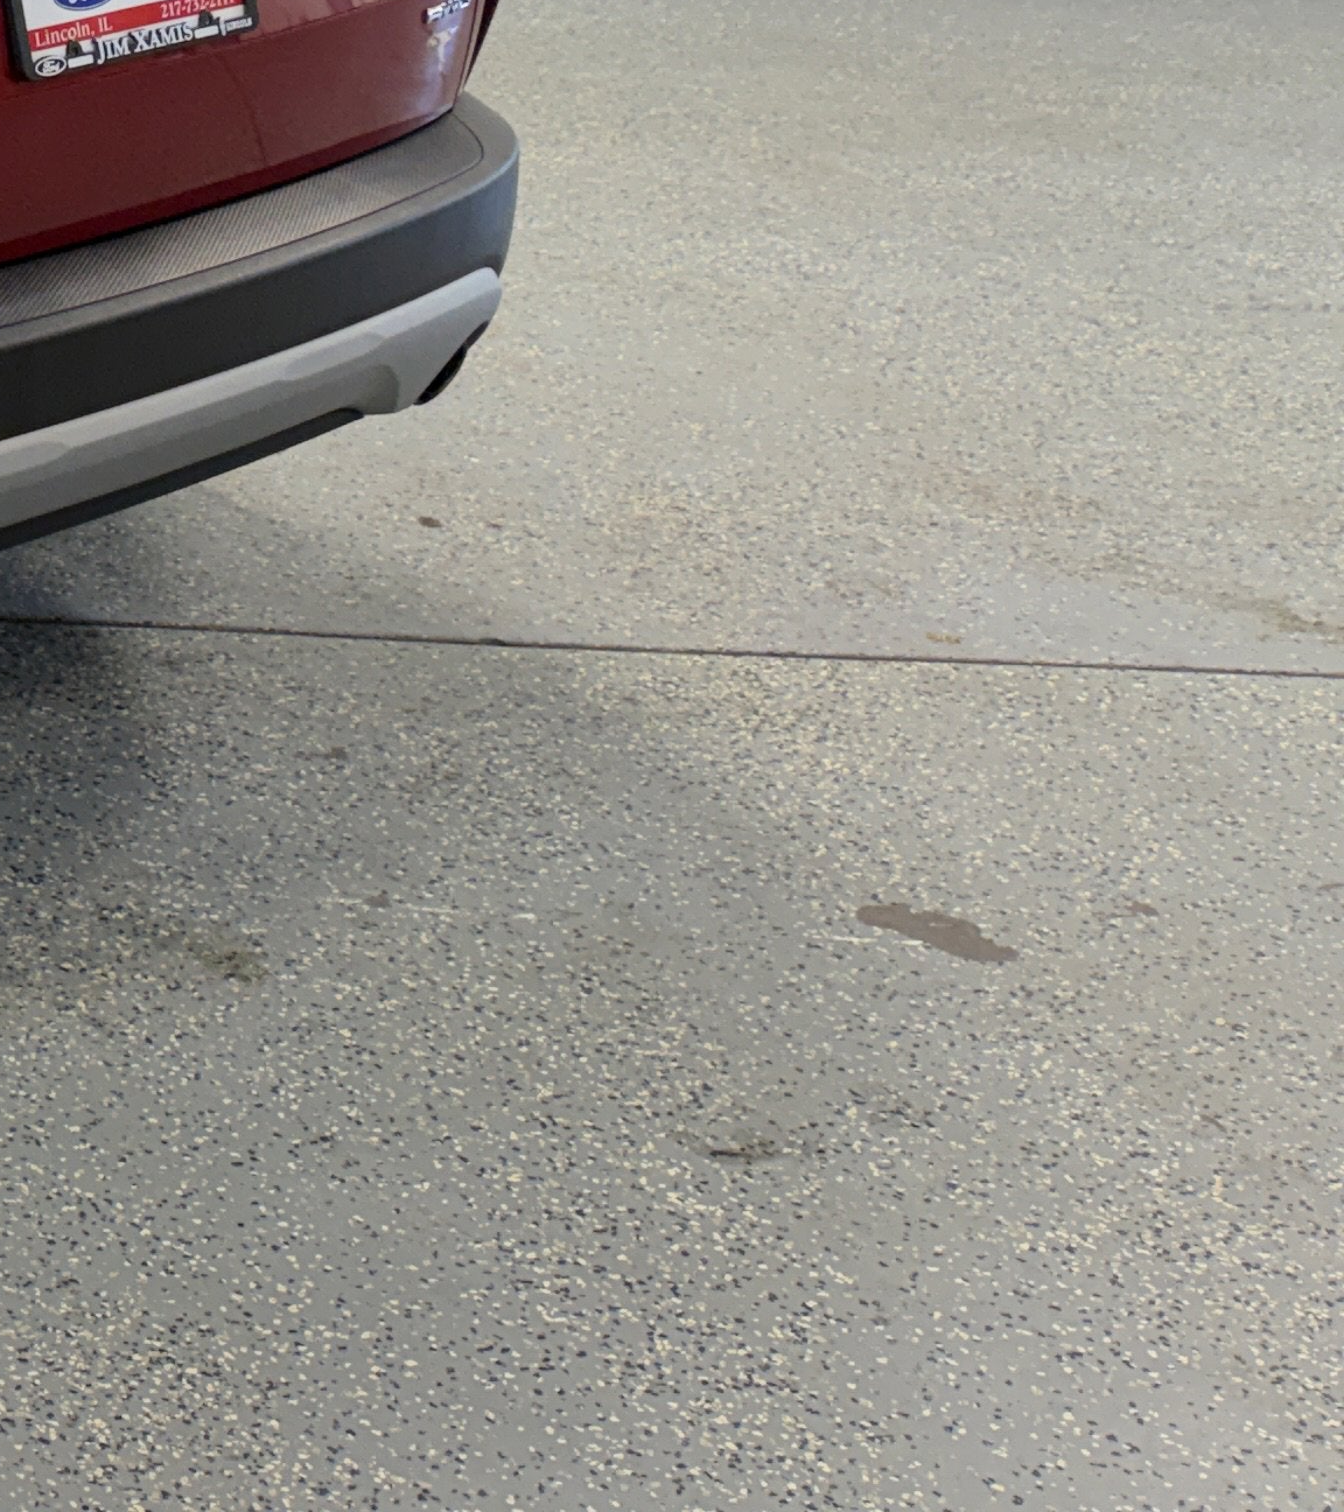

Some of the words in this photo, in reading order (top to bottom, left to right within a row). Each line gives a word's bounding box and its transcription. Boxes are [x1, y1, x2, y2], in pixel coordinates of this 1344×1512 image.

[34, 21, 96, 48] Lincoln,
[98, 17, 113, 33] IL
[97, 39, 130, 65] JIM
[130, 25, 194, 54] XAMIS
